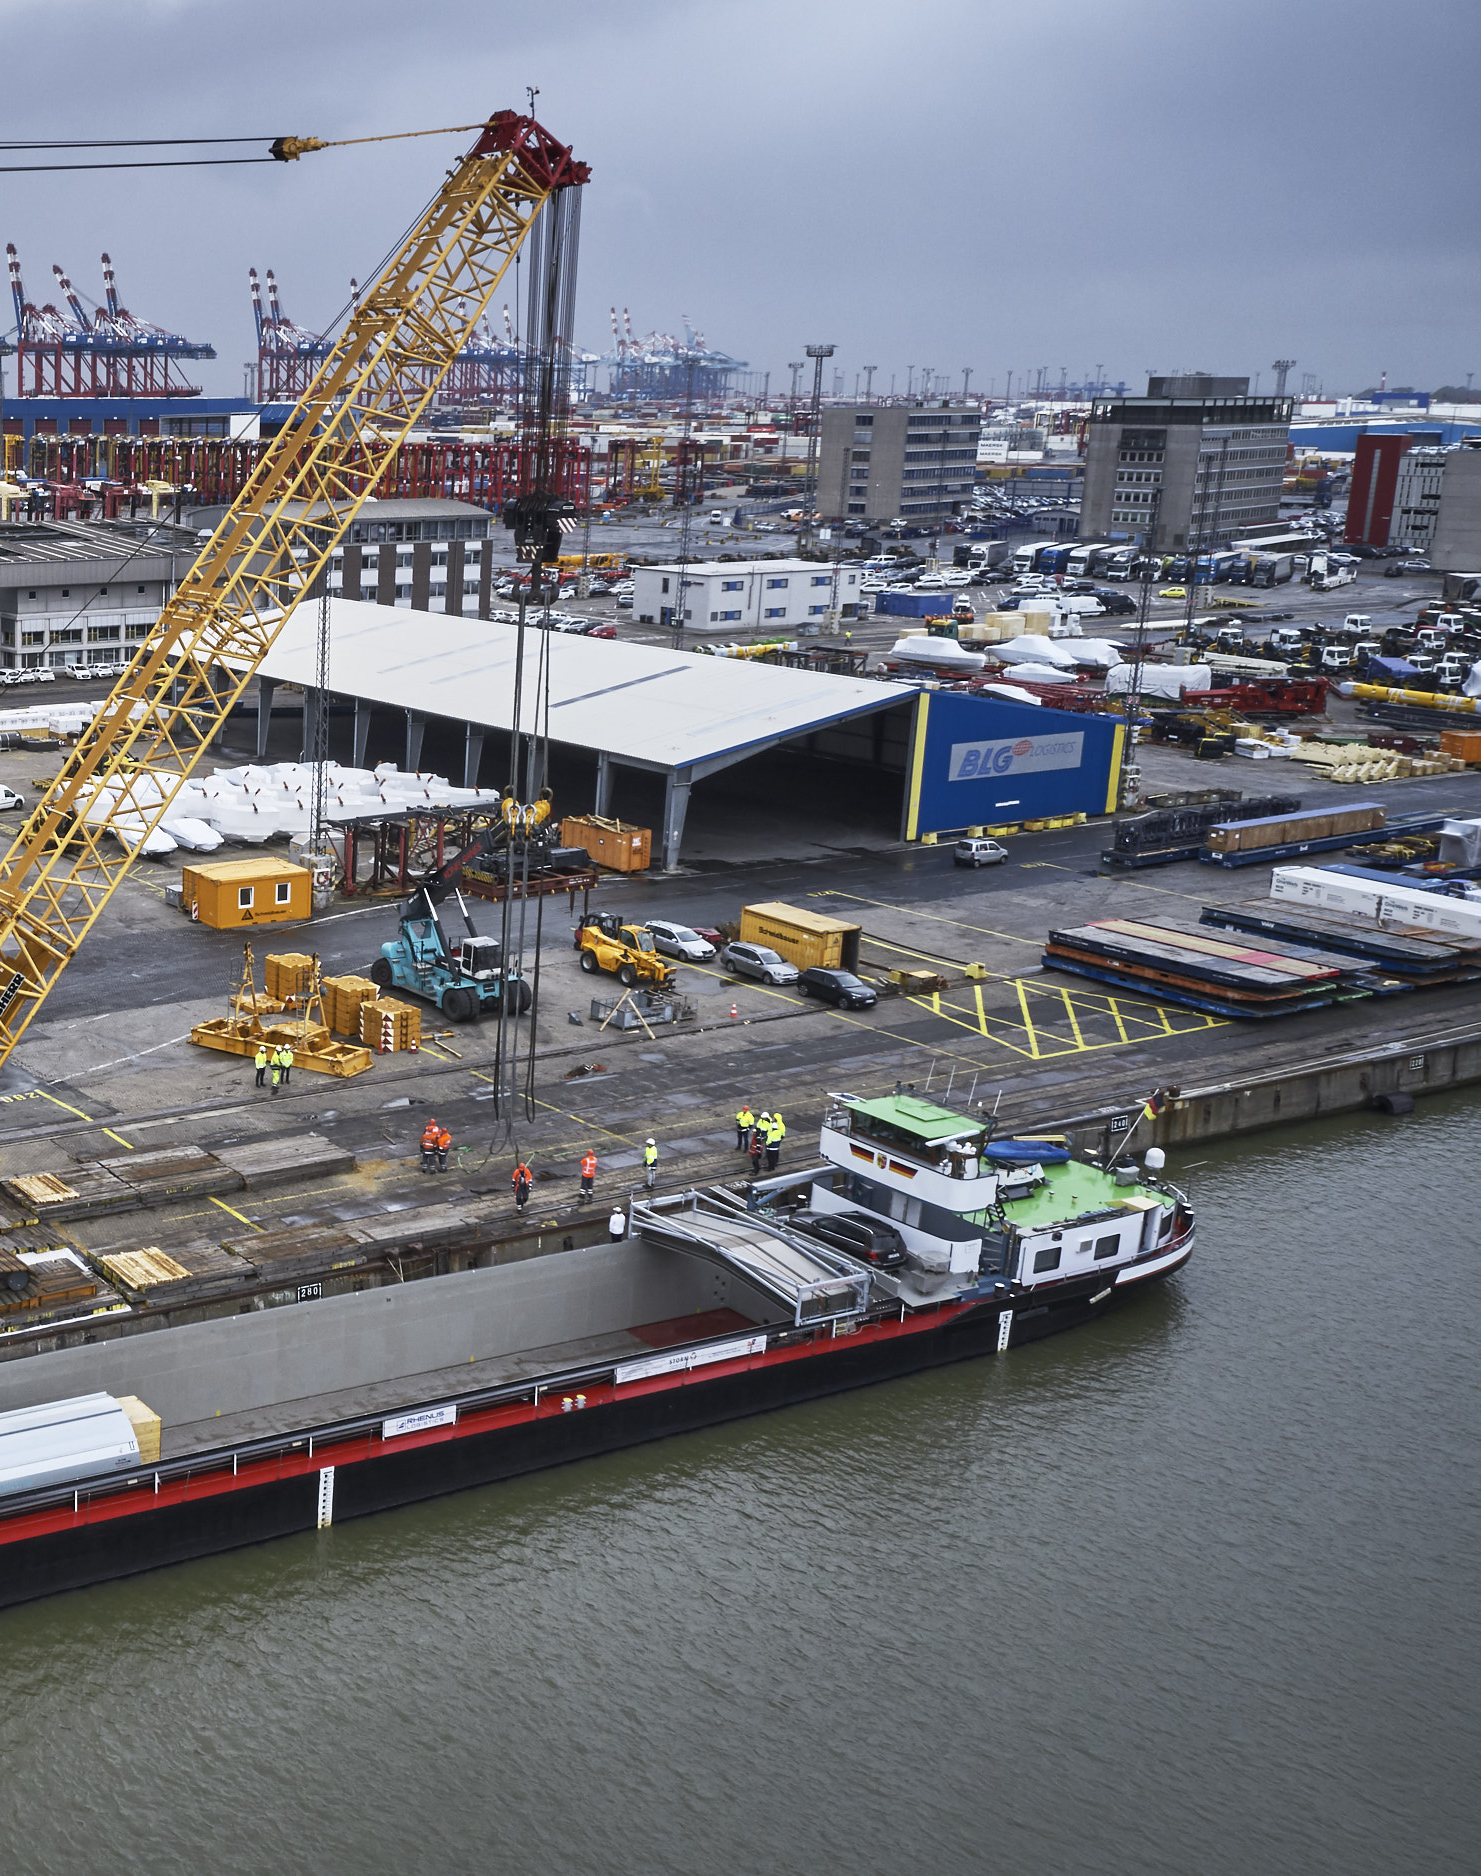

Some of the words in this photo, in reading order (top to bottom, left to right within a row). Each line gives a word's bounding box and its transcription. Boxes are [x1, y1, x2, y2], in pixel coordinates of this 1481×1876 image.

[957, 745, 1014, 778] BLG
[1029, 741, 1077, 757] LOGISTICS
[758, 926, 799, 944] Schmidbauer
[301, 1286, 319, 1298] 280
[406, 1410, 445, 1425] RHENUS
[406, 1418, 444, 1430] LOGISTICS
